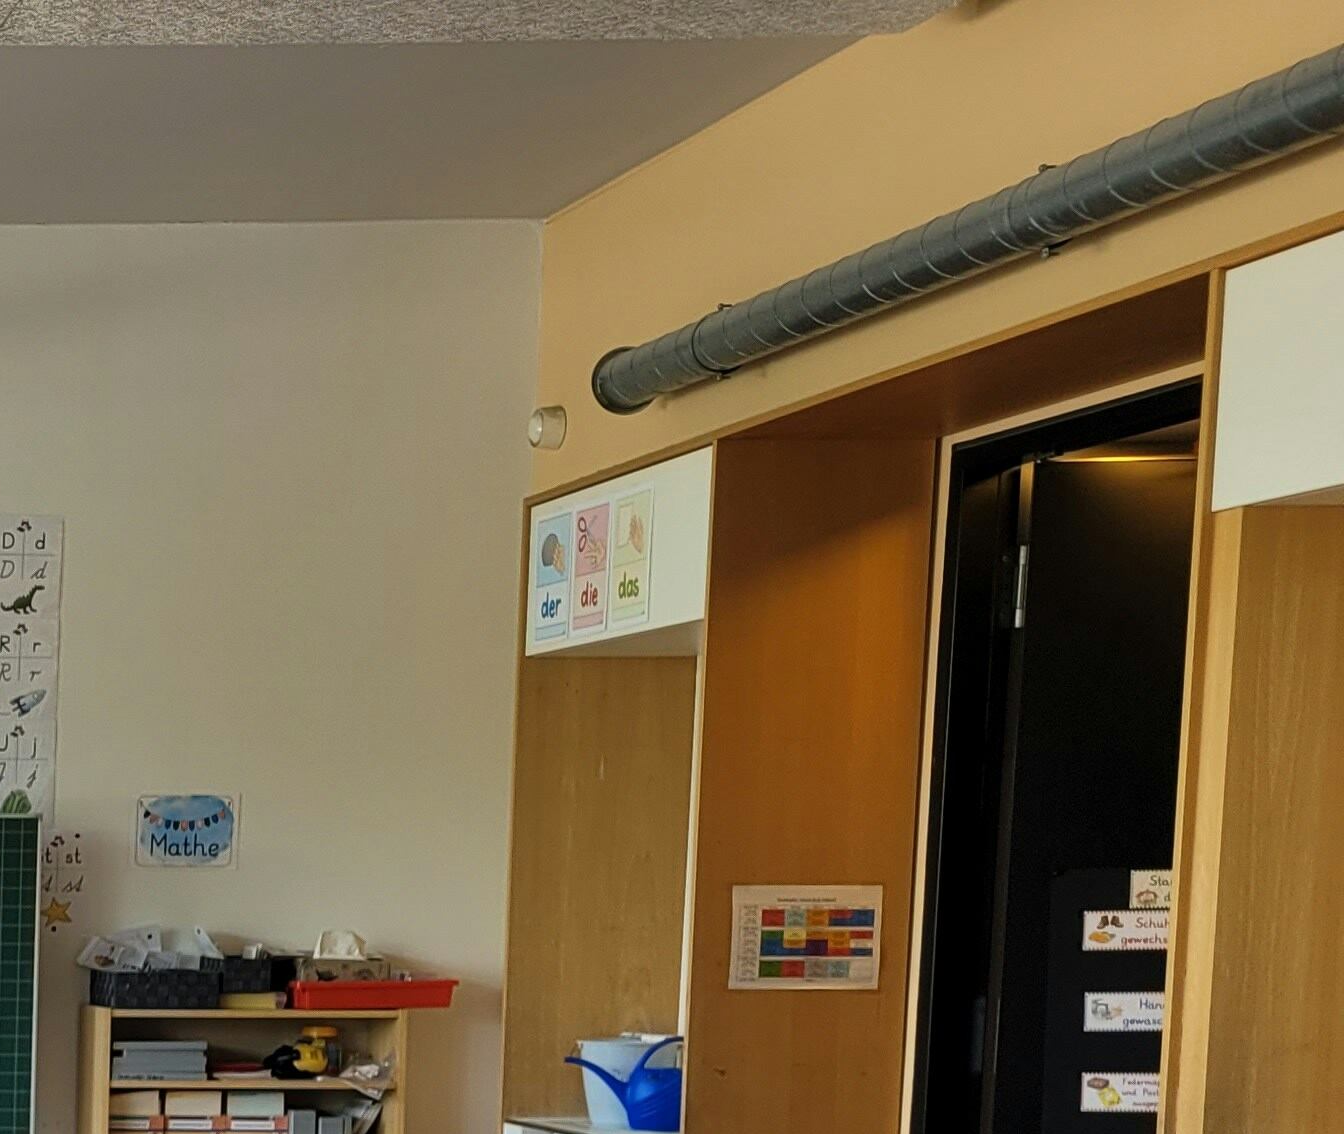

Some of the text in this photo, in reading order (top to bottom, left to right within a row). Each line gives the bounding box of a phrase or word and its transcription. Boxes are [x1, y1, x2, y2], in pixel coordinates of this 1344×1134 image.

[3, 533, 46, 550] D d
[0, 560, 47, 580] D d
[580, 581, 598, 608] die
[618, 572, 639, 599] das
[541, 592, 562, 618] der
[0, 636, 41, 653] R r
[31, 739, 38, 758] j
[66, 847, 82, 864] st
[149, 834, 220, 858] Mathe
[1149, 875, 1172, 886] Sta
